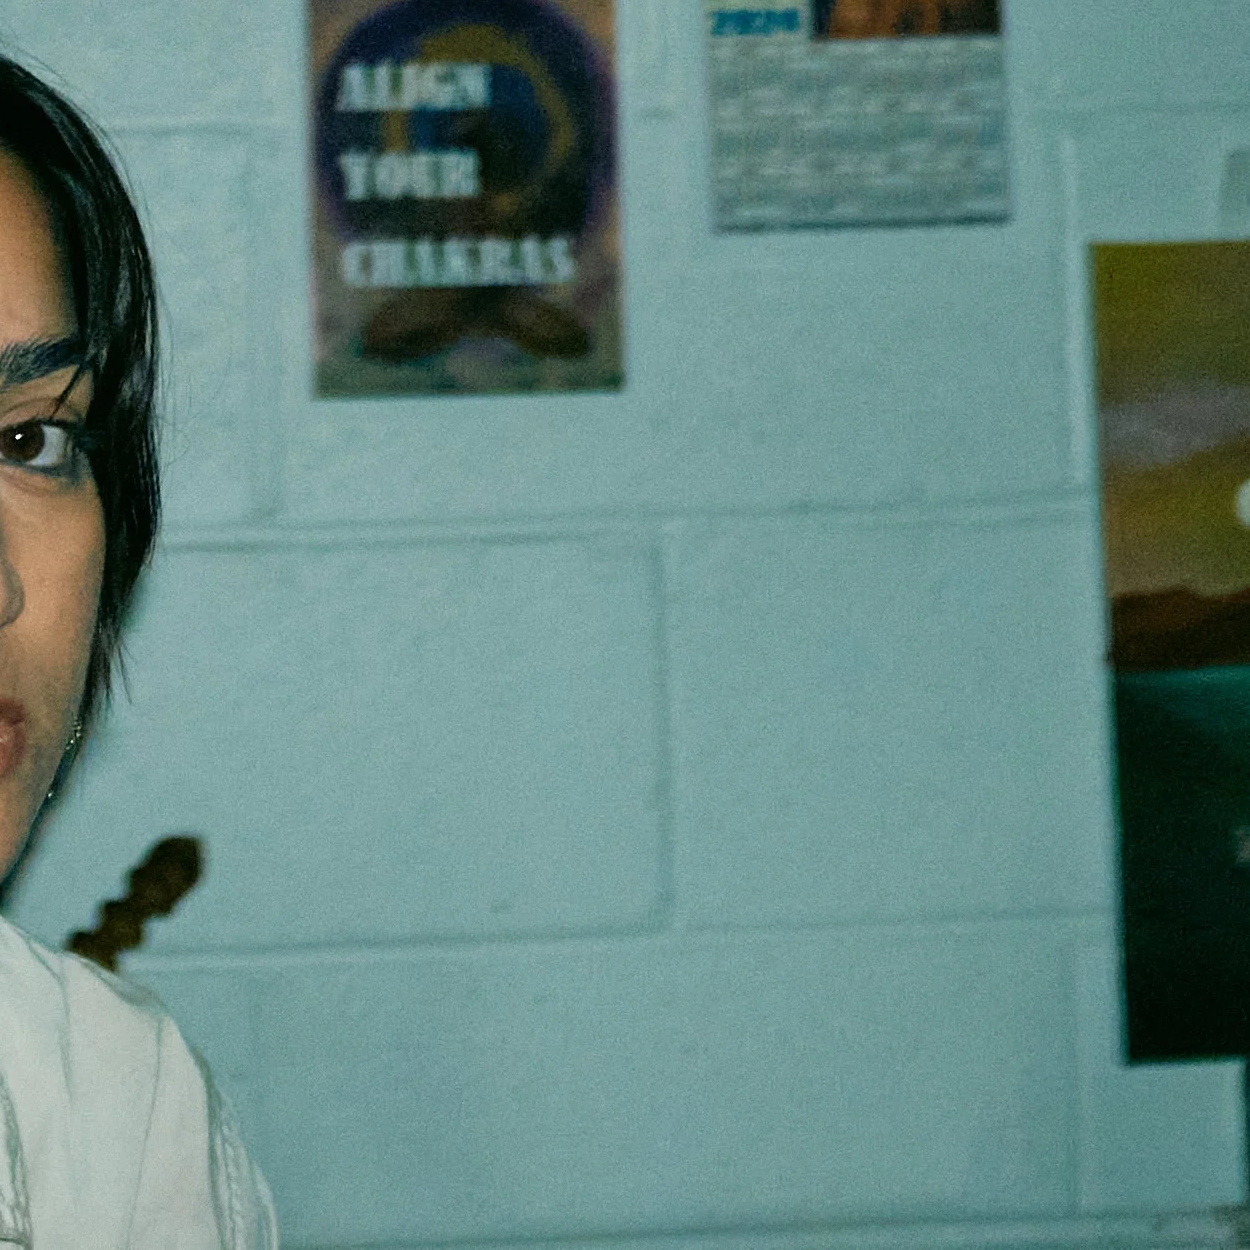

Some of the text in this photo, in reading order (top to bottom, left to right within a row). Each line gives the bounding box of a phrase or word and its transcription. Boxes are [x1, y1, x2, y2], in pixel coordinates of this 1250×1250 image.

[336, 61, 493, 111] ALIGN
[340, 151, 481, 199] YOUR
[343, 235, 578, 288] CHAKRAS
